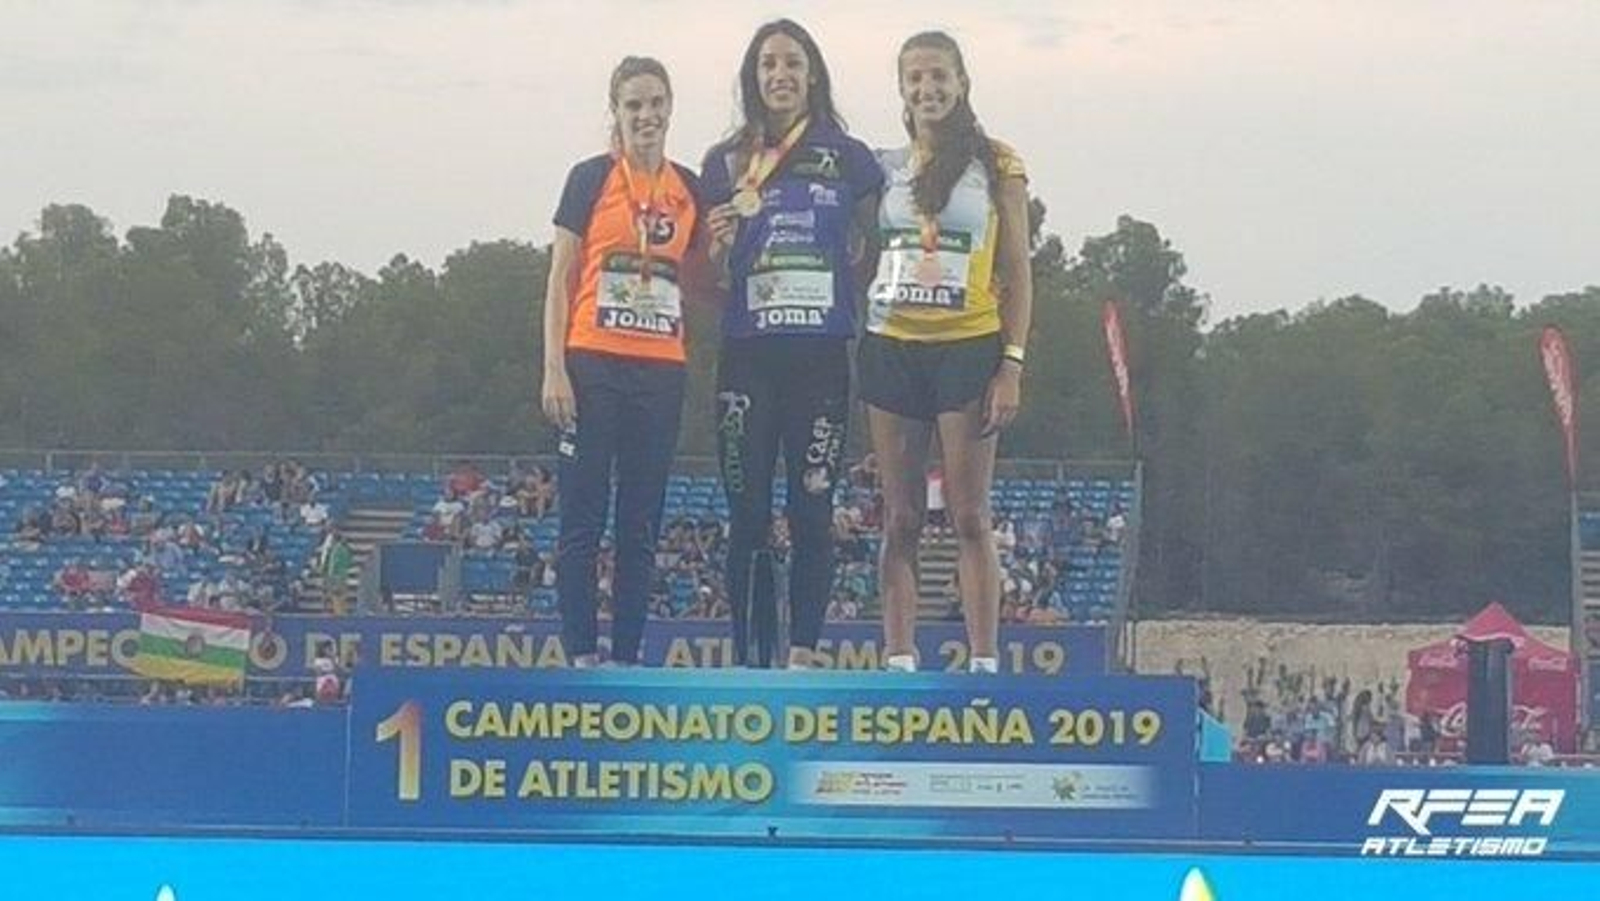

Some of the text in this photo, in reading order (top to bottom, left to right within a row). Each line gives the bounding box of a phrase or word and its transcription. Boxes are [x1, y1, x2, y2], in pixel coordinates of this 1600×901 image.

[382, 624, 566, 668] ESPAÑA
[939, 641, 1064, 675] 219
[445, 699, 1161, 745] CAMPEONATO DE ESPAÑA 2019
[376, 699, 422, 800] 1
[450, 759, 506, 798] DE
[517, 760, 773, 802] ATLETISMO
